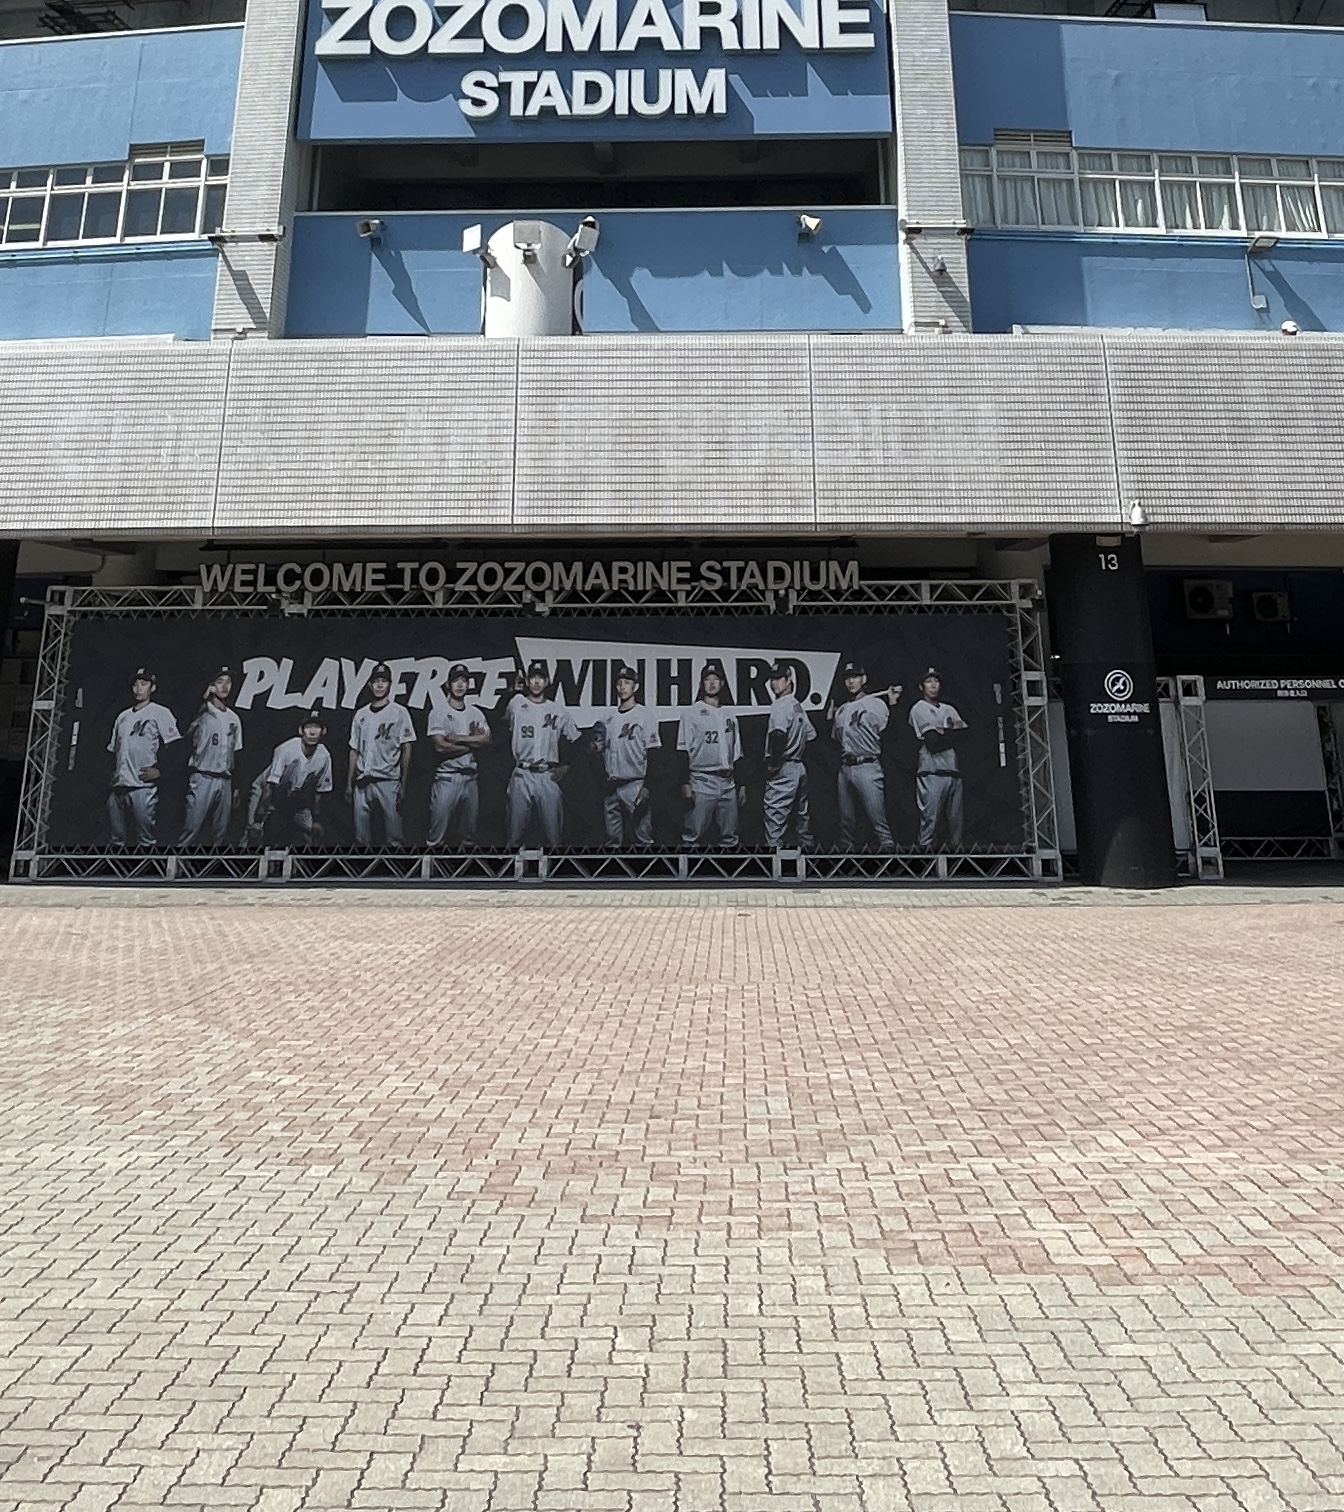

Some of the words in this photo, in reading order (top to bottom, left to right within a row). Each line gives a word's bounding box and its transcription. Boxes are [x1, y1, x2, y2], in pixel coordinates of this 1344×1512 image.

[458, 68, 727, 119] STADIUM
[1098, 553, 1119, 571] 13
[199, 561, 387, 593] WELCOME
[397, 560, 447, 592] TO
[455, 560, 692, 592] ZOZOMARINE
[700, 560, 859, 591] STADIUM
[235, 656, 379, 710] PLAY
[528, 658, 646, 707] WIN
[1216, 679, 1279, 690] AUTHORIZED
[1280, 679, 1338, 689] PERSONNEL
[1089, 702, 1151, 714] ZOZOMARINE
[521, 725, 535, 739] 99
[704, 730, 719, 745] 32
